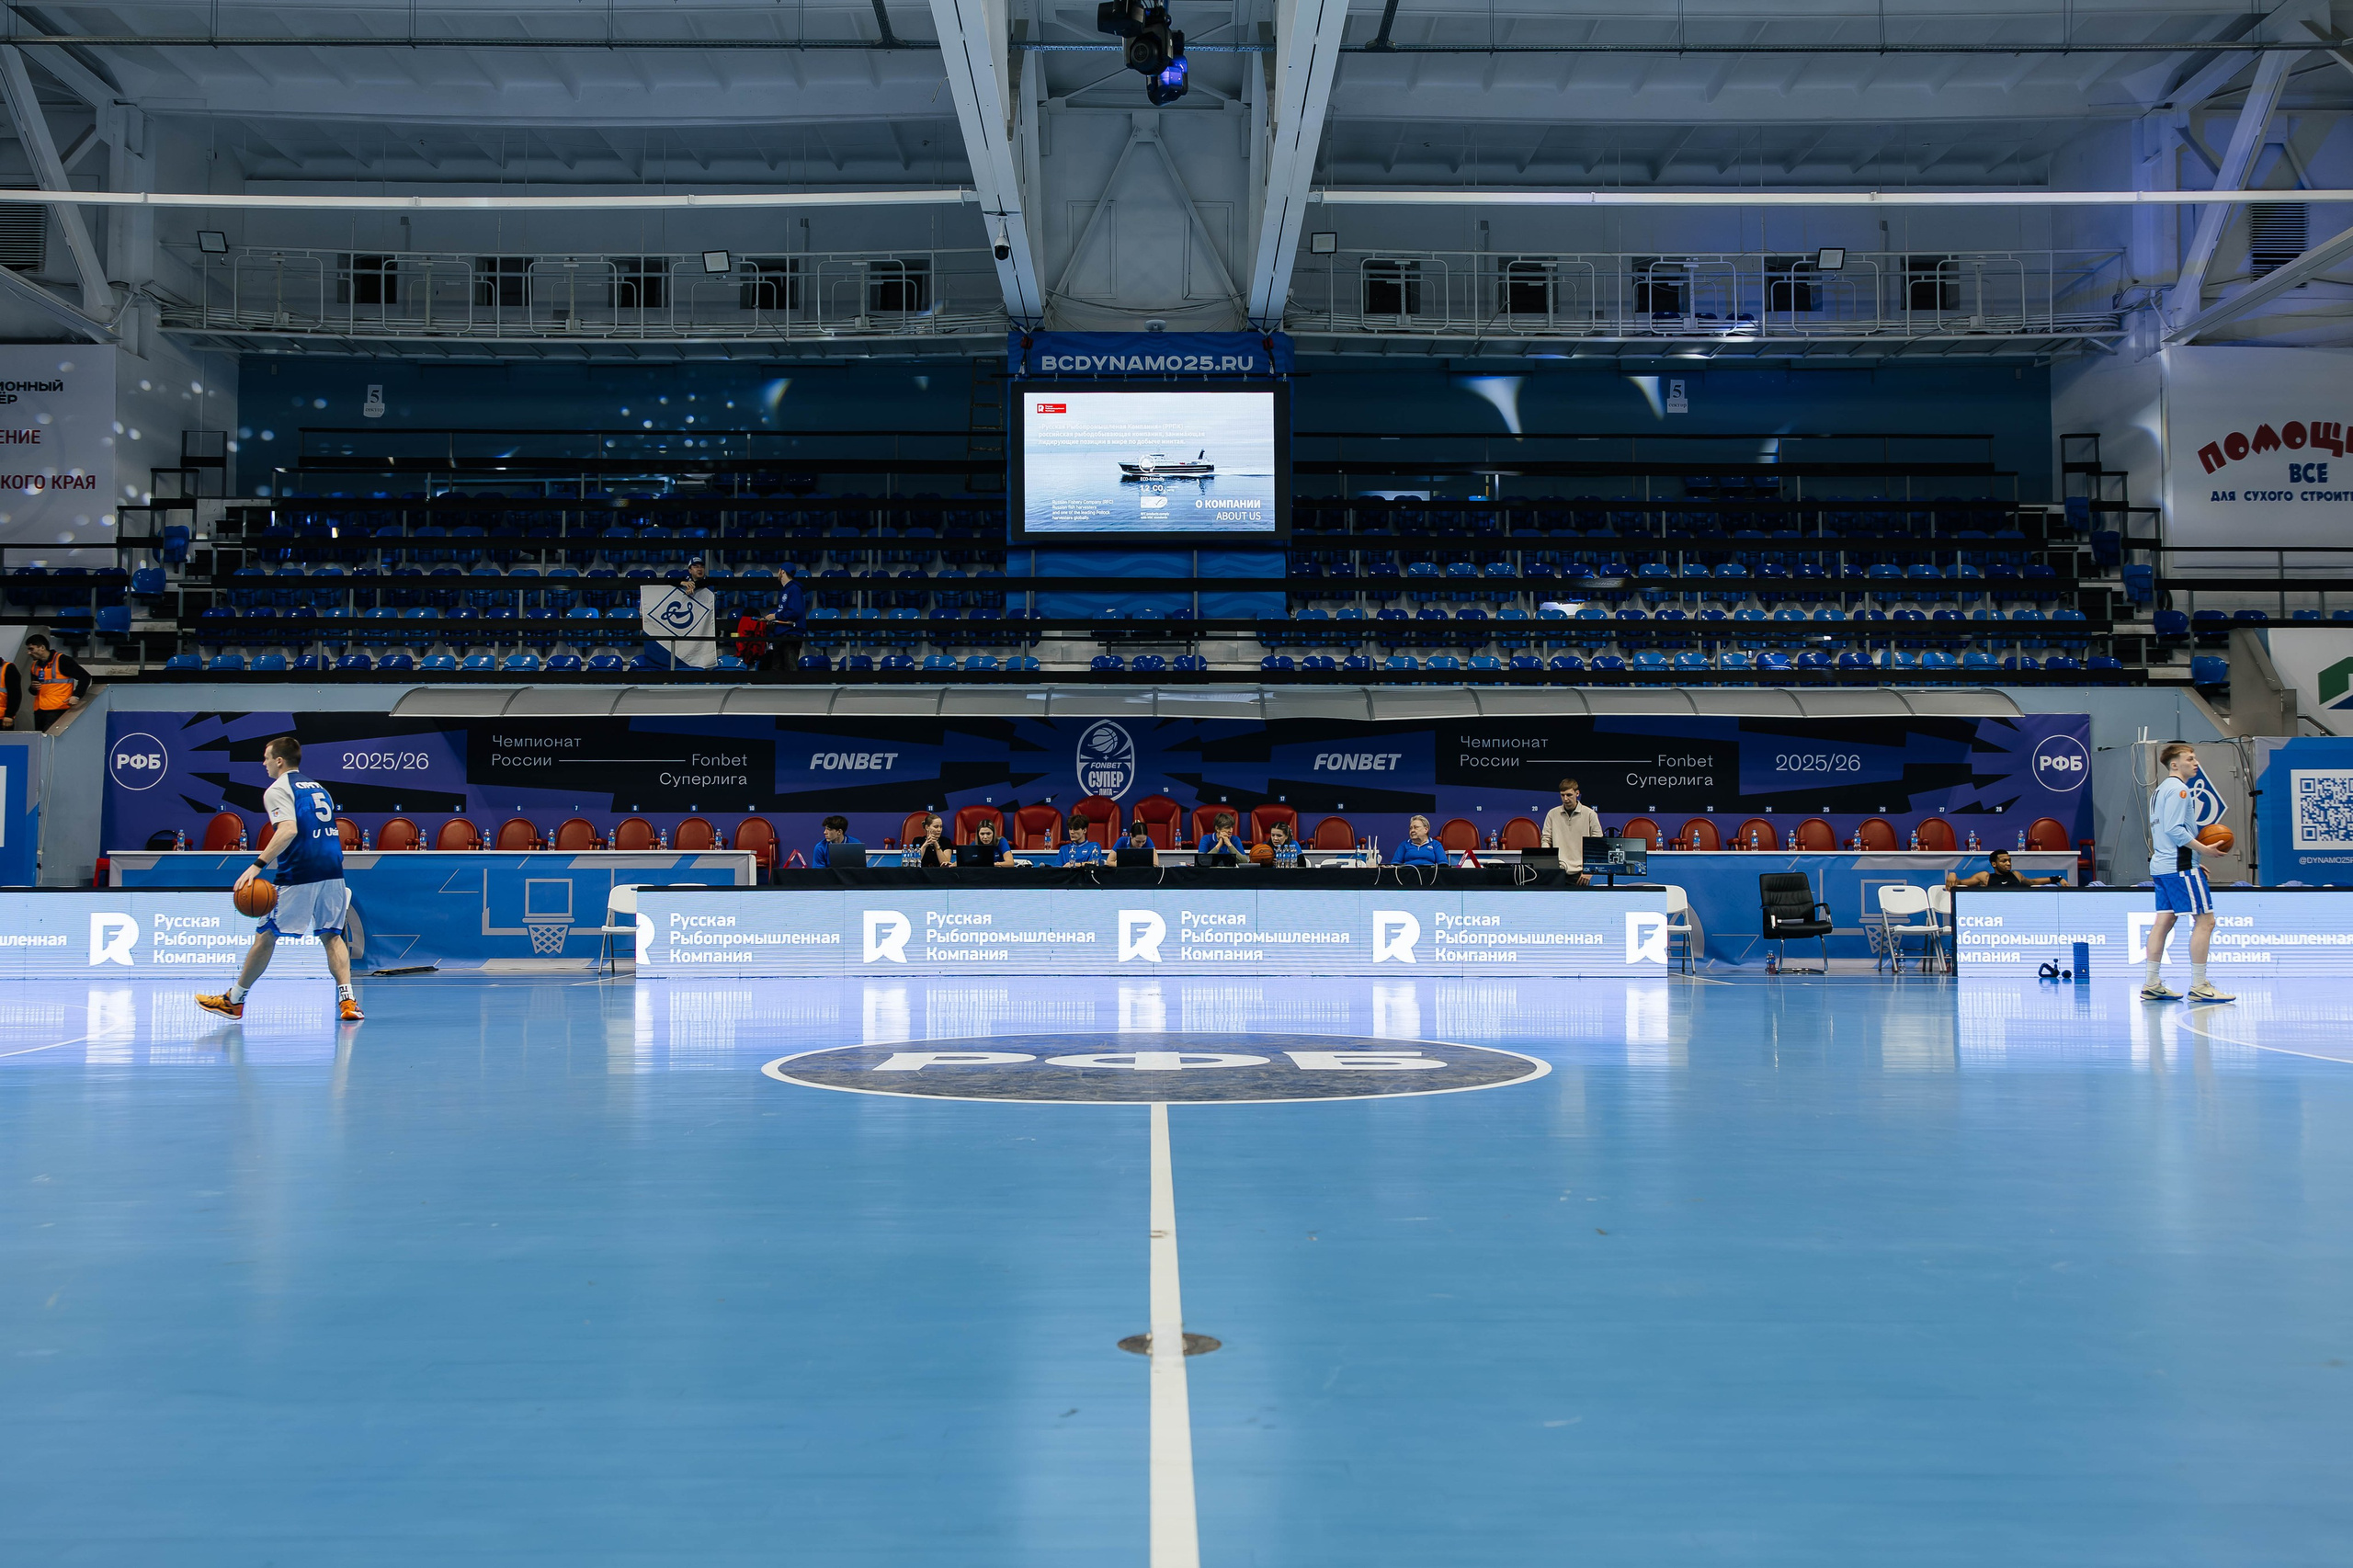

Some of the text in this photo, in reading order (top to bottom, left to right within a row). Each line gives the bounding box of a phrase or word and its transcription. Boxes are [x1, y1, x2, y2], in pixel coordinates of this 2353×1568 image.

[1041, 356, 1254, 370] BCDYNAMO25.RU
[369, 390, 380, 403] 5
[1673, 384, 1682, 398] 5
[2289, 463, 2328, 483] ВСЕ
[51, 475, 96, 489] КРАЯ
[1195, 499, 1261, 508] О КОМПАНИИ
[2211, 491, 2236, 502] ДЛЯ
[2244, 491, 2293, 502] СУХОГО
[1216, 512, 1261, 520] ABOUT US
[493, 736, 581, 749] Чемпионат
[1461, 736, 1548, 750] Чемпионат
[117, 754, 161, 769] РФБ
[342, 752, 429, 771] 2025/26
[492, 754, 747, 767] России Fonbet
[810, 753, 898, 769] FONBET
[1313, 754, 1402, 770] FONBET
[1460, 755, 1713, 767] России Fonbet
[1775, 754, 1861, 773] 2025/26
[2040, 756, 2083, 772] РФБ
[659, 773, 747, 787] Суперлига
[1088, 771, 1124, 788] СУПЕР
[1626, 774, 1713, 788] Суперлига
[311, 792, 332, 822] 5
[154, 914, 220, 930] Русская
[670, 914, 735, 929] Русская
[926, 912, 992, 928] Русская
[1181, 912, 1245, 928] Русская
[1436, 913, 1500, 928] Русская
[1956, 916, 2003, 926] сская
[154, 931, 322, 948] Рыбопромыенная
[670, 930, 839, 947] Рыбопромышленная
[926, 928, 1095, 945] Рыбопромышленная
[1181, 929, 1349, 945] Рыбопромышленная
[1436, 929, 1603, 946] Рыбопромышленная
[2189, 930, 2353, 948] бопромышленная
[153, 950, 235, 963] Компания
[670, 949, 752, 962] Компания
[926, 948, 1007, 960] Компания
[1181, 948, 1262, 960] Компания
[1436, 948, 1517, 961] Компания
[2207, 952, 2270, 962] мпания
[872, 1051, 1448, 1071] РФБ
